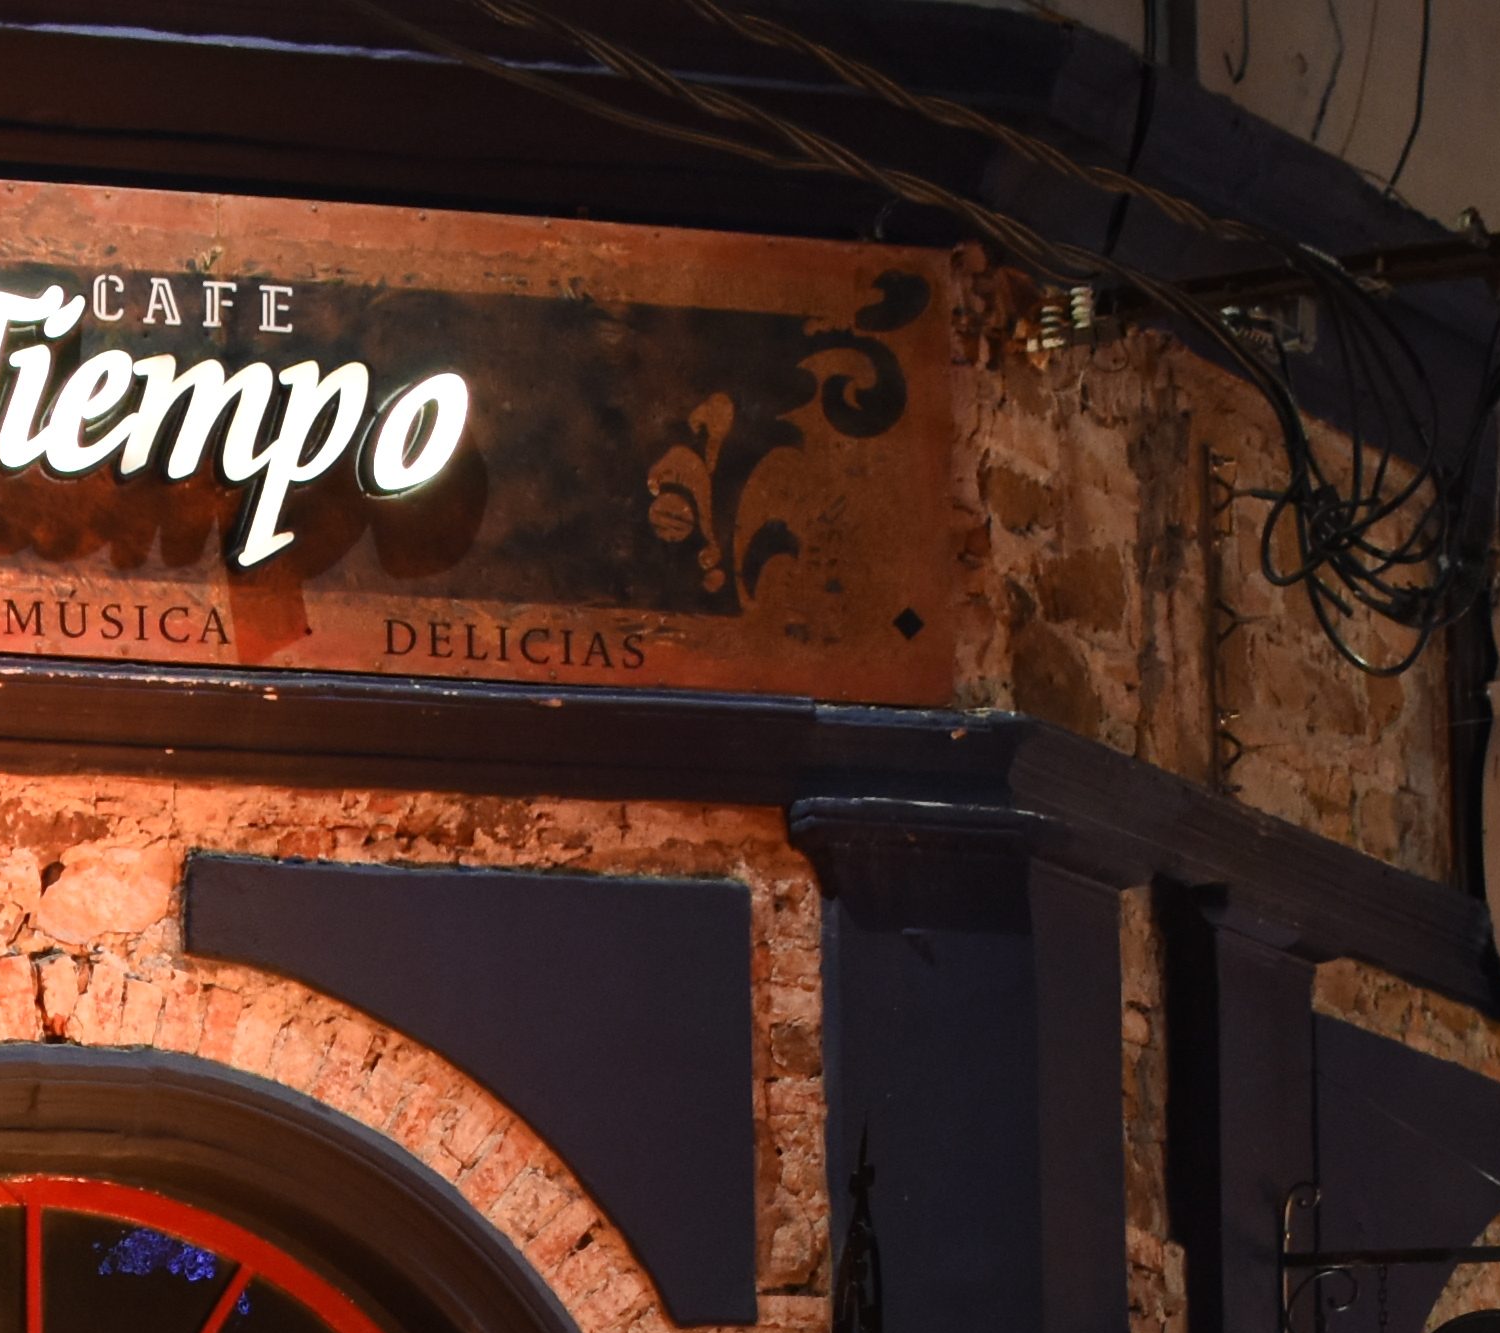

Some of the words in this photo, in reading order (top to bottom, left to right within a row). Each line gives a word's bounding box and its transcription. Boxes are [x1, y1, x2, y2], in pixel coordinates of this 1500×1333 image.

[91, 274, 295, 334] CAFE
[3, 590, 232, 646] MÚSICA
[383, 618, 646, 670] DELICIAS
